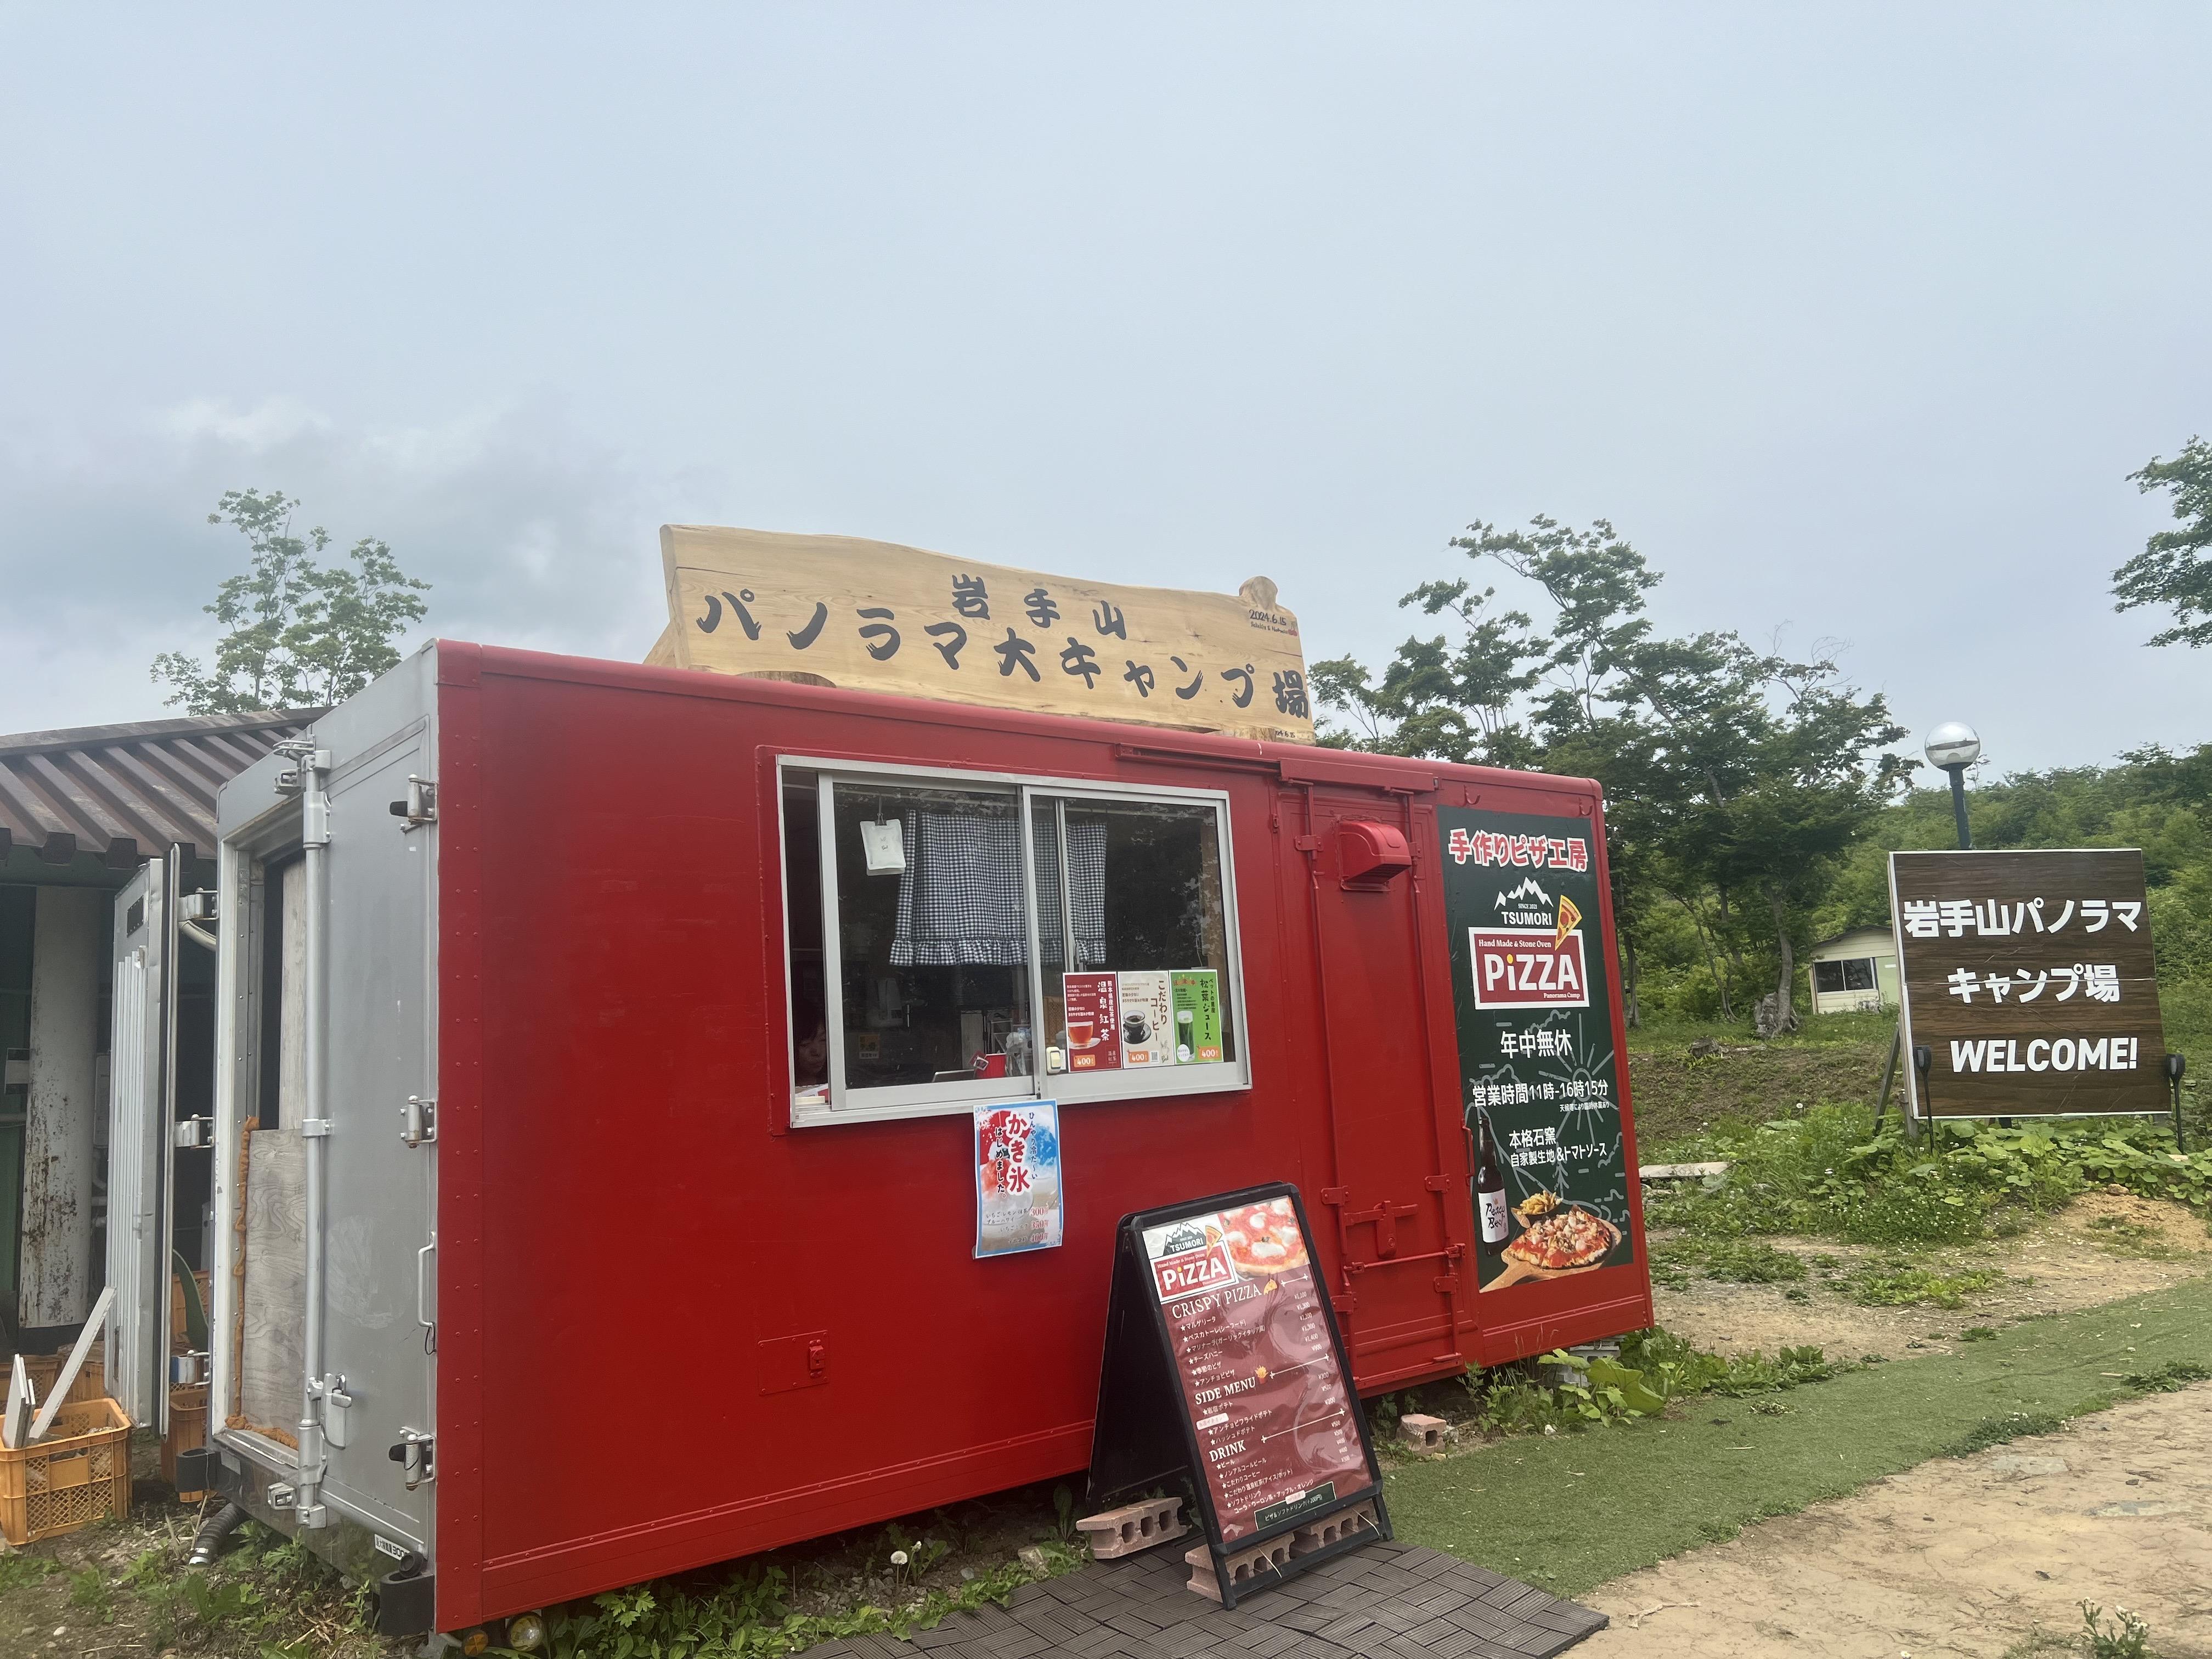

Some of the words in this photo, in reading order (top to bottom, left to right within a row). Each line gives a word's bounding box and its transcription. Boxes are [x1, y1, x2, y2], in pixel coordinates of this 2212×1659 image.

[952, 574, 1126, 642] 岩手山
[696, 588, 1309, 720] パノラマ大キャンプ場
[1448, 828, 1588, 872] 手作りピザ工房
[1501, 911, 1552, 926] TSUMORI
[1903, 897, 2141, 938] 岩手山パノラマ
[1159, 980, 1167, 1025] こだわり
[1948, 963, 2119, 1003] キャンプ場
[1097, 981, 1110, 1041] 温泉紅茶
[1150, 998, 1159, 1041] コーヒー
[1200, 979, 1211, 1040] 松葉ジュース
[1500, 1029, 1572, 1059] 年中無休
[1950, 1037, 2137, 1073] WELCOME!
[1008, 1114, 1030, 1193] かき氷
[1509, 1126, 1556, 1149] 本格石窯
[995, 1127, 1006, 1198] はじめました。
[1170, 1238, 1204, 1252] TSUMORI
[1172, 1294, 1221, 1319] CRISPY
[1224, 1284, 1262, 1304] PIZZA
[1186, 1317, 1216, 1328] マルゲリータ
[1194, 1351, 1223, 1363] チーズハニー
[1195, 1387, 1222, 1404] SIDE
[1223, 1376, 1256, 1396] MENU
[1209, 1440, 1246, 1462] DRINK
